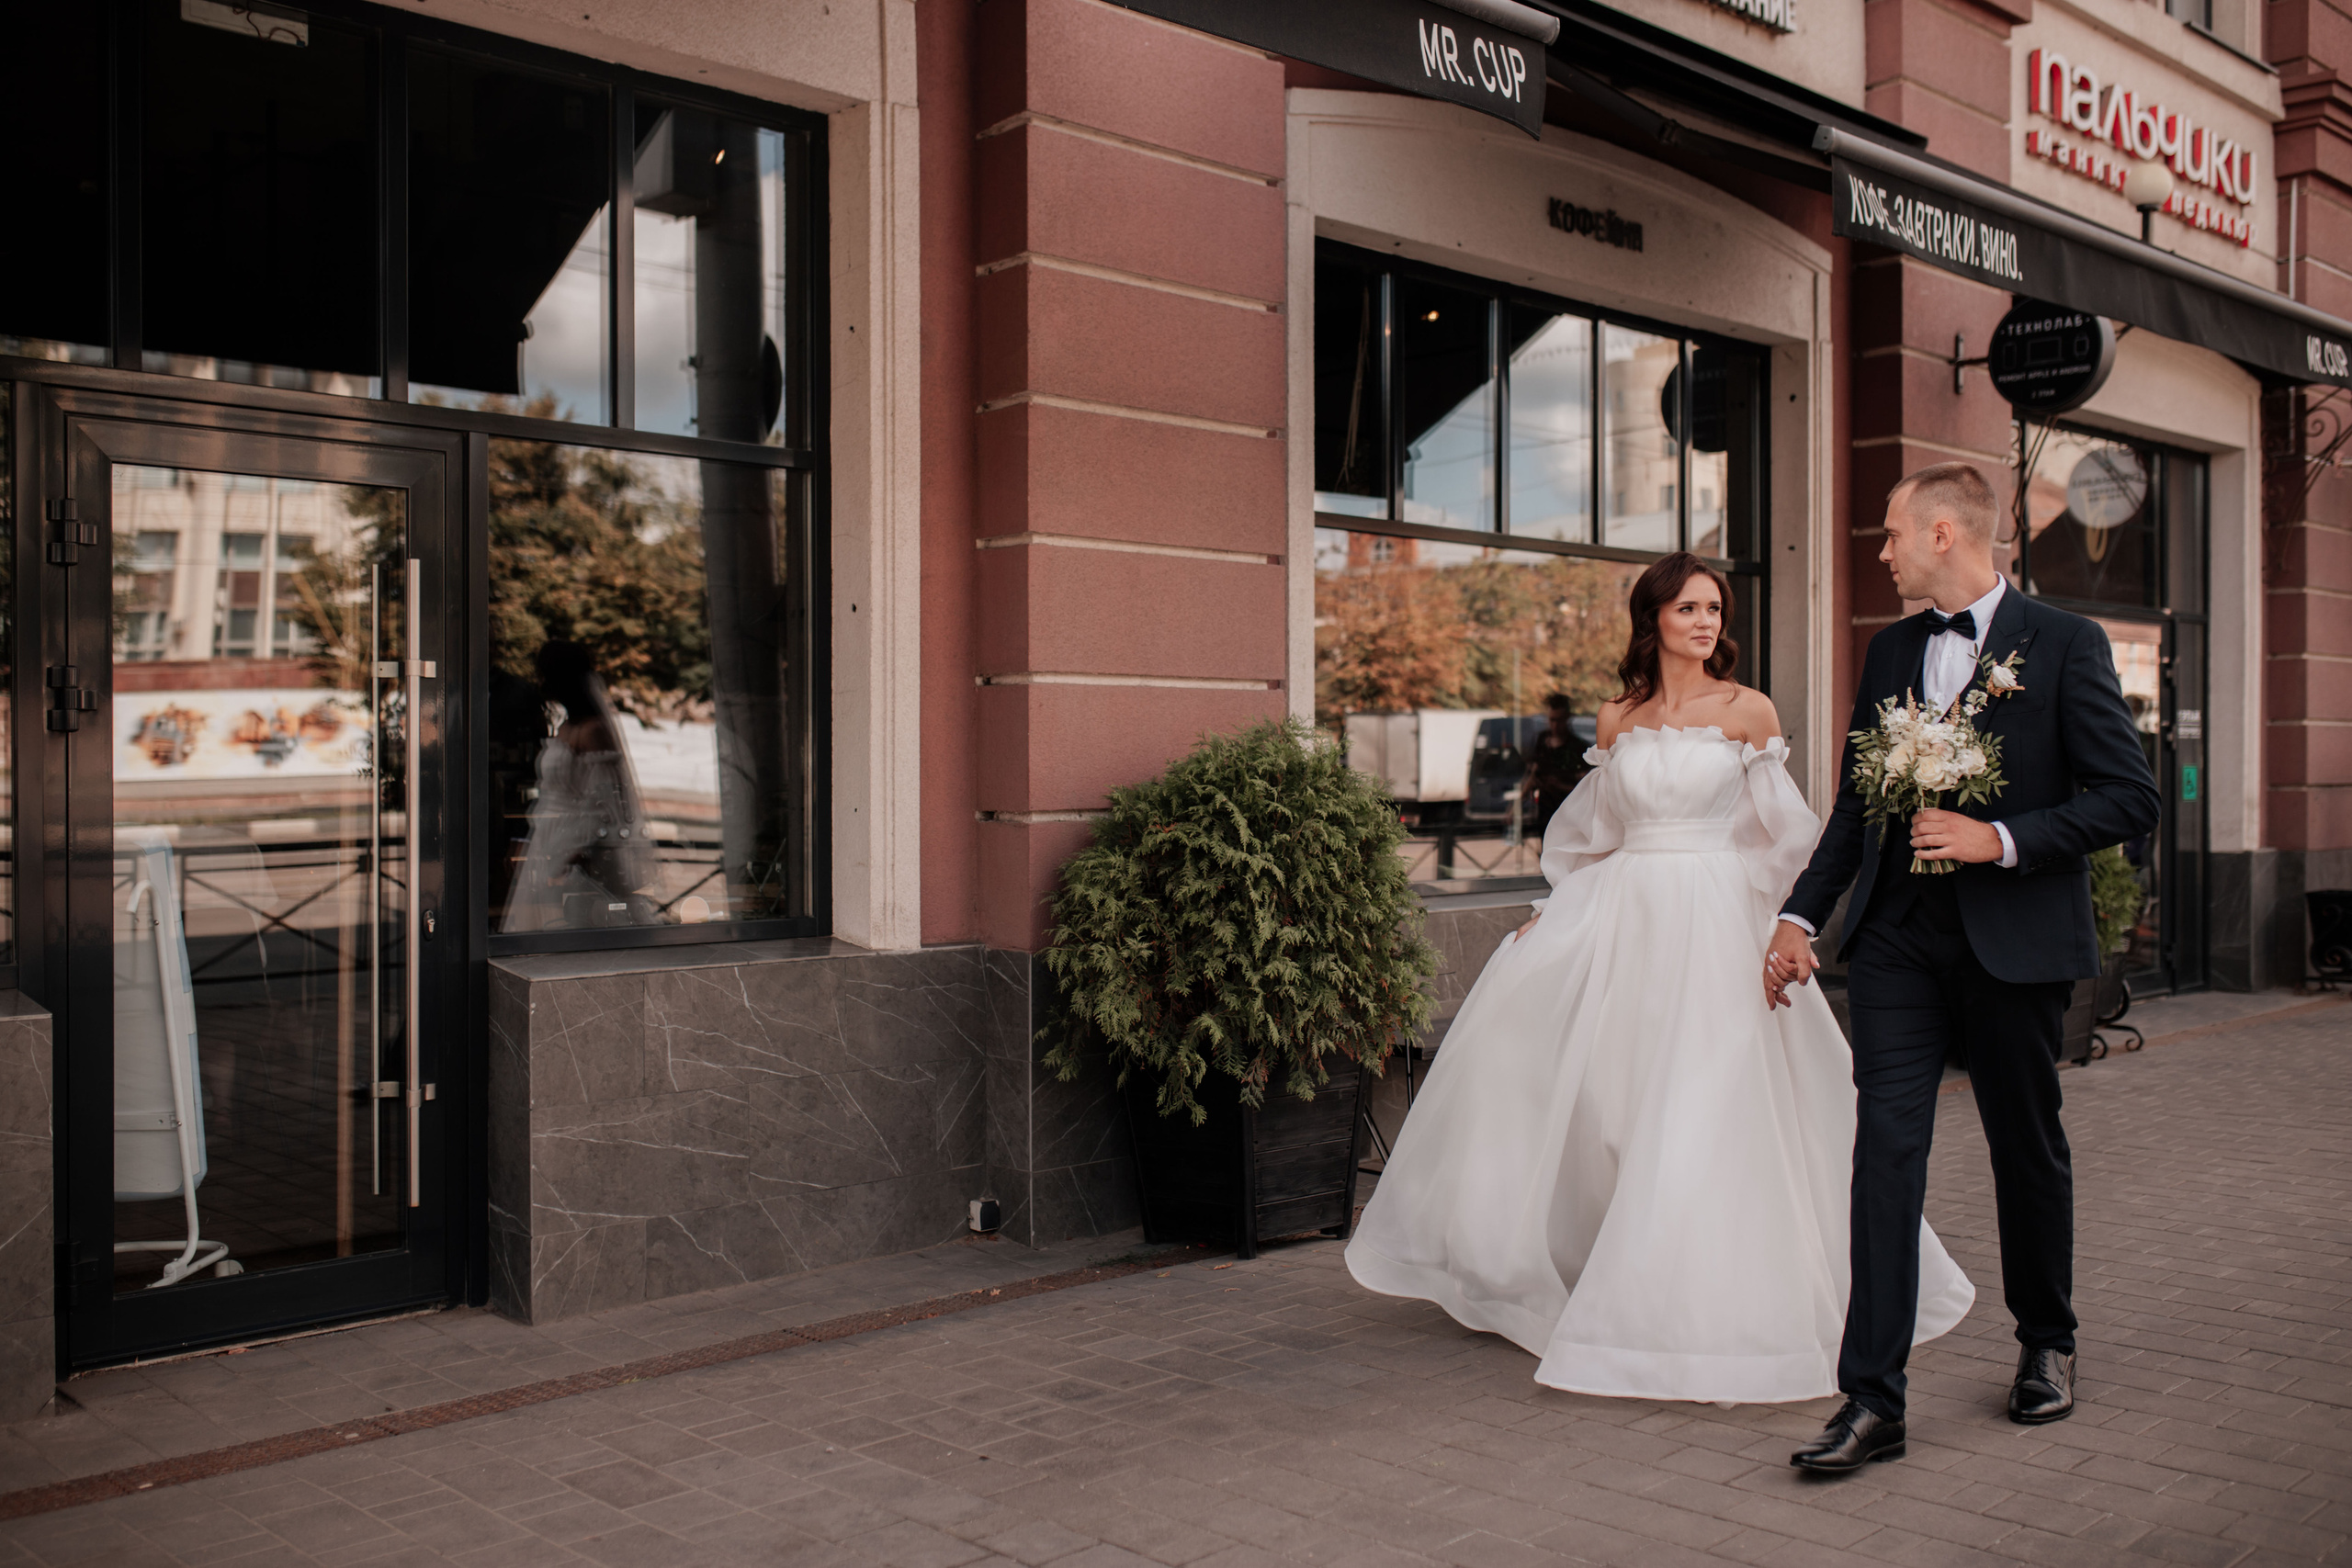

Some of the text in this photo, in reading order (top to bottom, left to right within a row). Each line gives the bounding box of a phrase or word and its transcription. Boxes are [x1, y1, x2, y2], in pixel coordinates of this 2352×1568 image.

[1419, 18, 1526, 103] MR. CUP
[2031, 129, 2132, 189] маник
[1547, 196, 1643, 253] КОФЕЙНЯ
[1894, 194, 1980, 266] ЗАВТРАКИ.
[1980, 222, 2023, 281] ВИНО.
[2007, 313, 2084, 336] ТЕХНОЛАБ
[2324, 341, 2349, 378] CUP
